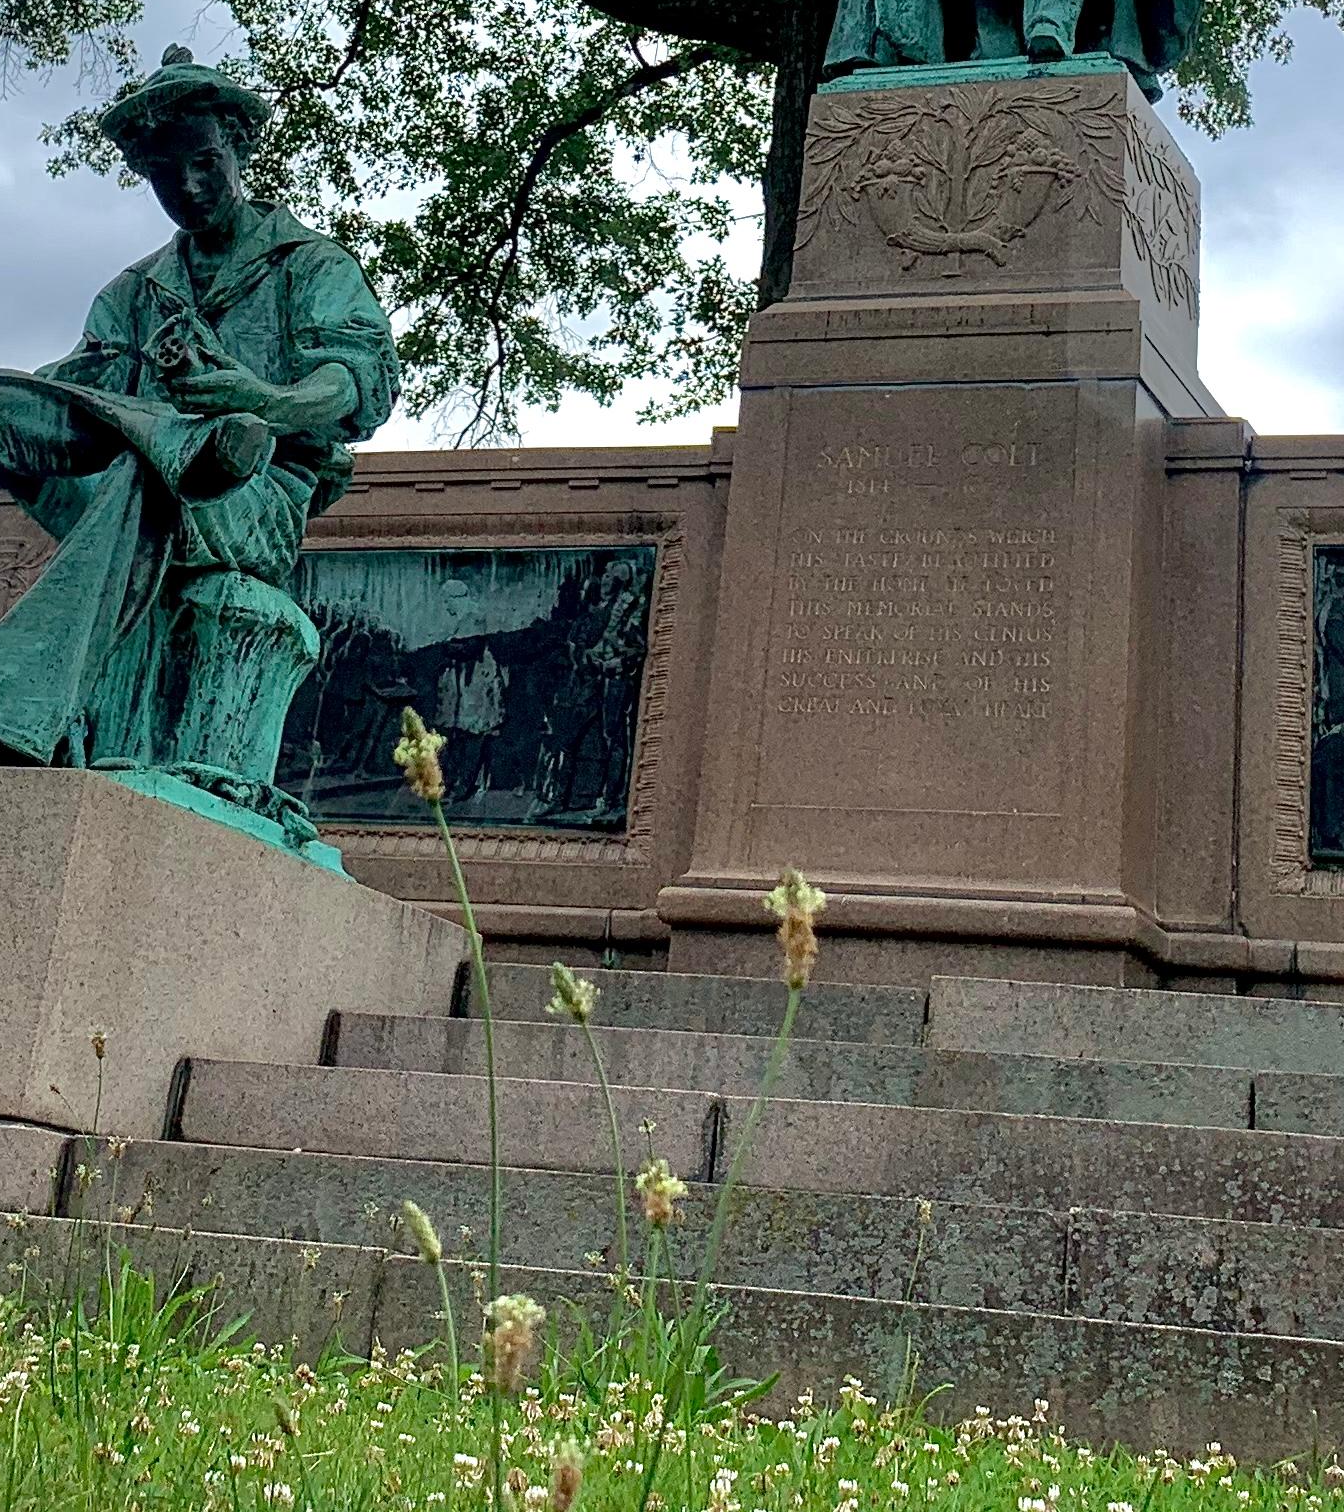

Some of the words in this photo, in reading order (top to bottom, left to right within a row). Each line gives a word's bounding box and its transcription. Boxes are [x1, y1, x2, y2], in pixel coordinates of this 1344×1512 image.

[816, 442, 941, 468] SAMUEL
[960, 441, 1043, 467] COLT
[834, 528, 867, 544] THE
[790, 552, 824, 568] HIS
[843, 552, 902, 568] TASTE
[824, 575, 859, 592] THE
[787, 599, 832, 617] THIS
[847, 600, 956, 617] MEMORIAL
[972, 600, 1055, 618] STANDS
[787, 623, 811, 639] TO
[822, 624, 883, 640] SPEAK
[893, 625, 916, 641] OF
[928, 625, 962, 641] HIS
[974, 625, 1053, 643] GENIUS
[782, 647, 812, 664] HIS
[825, 648, 944, 665] ENTERPRISE
[957, 649, 1003, 666] AND
[1015, 650, 1051, 667] HIS
[779, 671, 877, 688] SUCCESS
[965, 675, 994, 691] OF
[1013, 676, 1052, 693] HIS
[777, 695, 843, 714] GREAT
[848, 696, 898, 715] AND
[984, 700, 1052, 719] HEART
